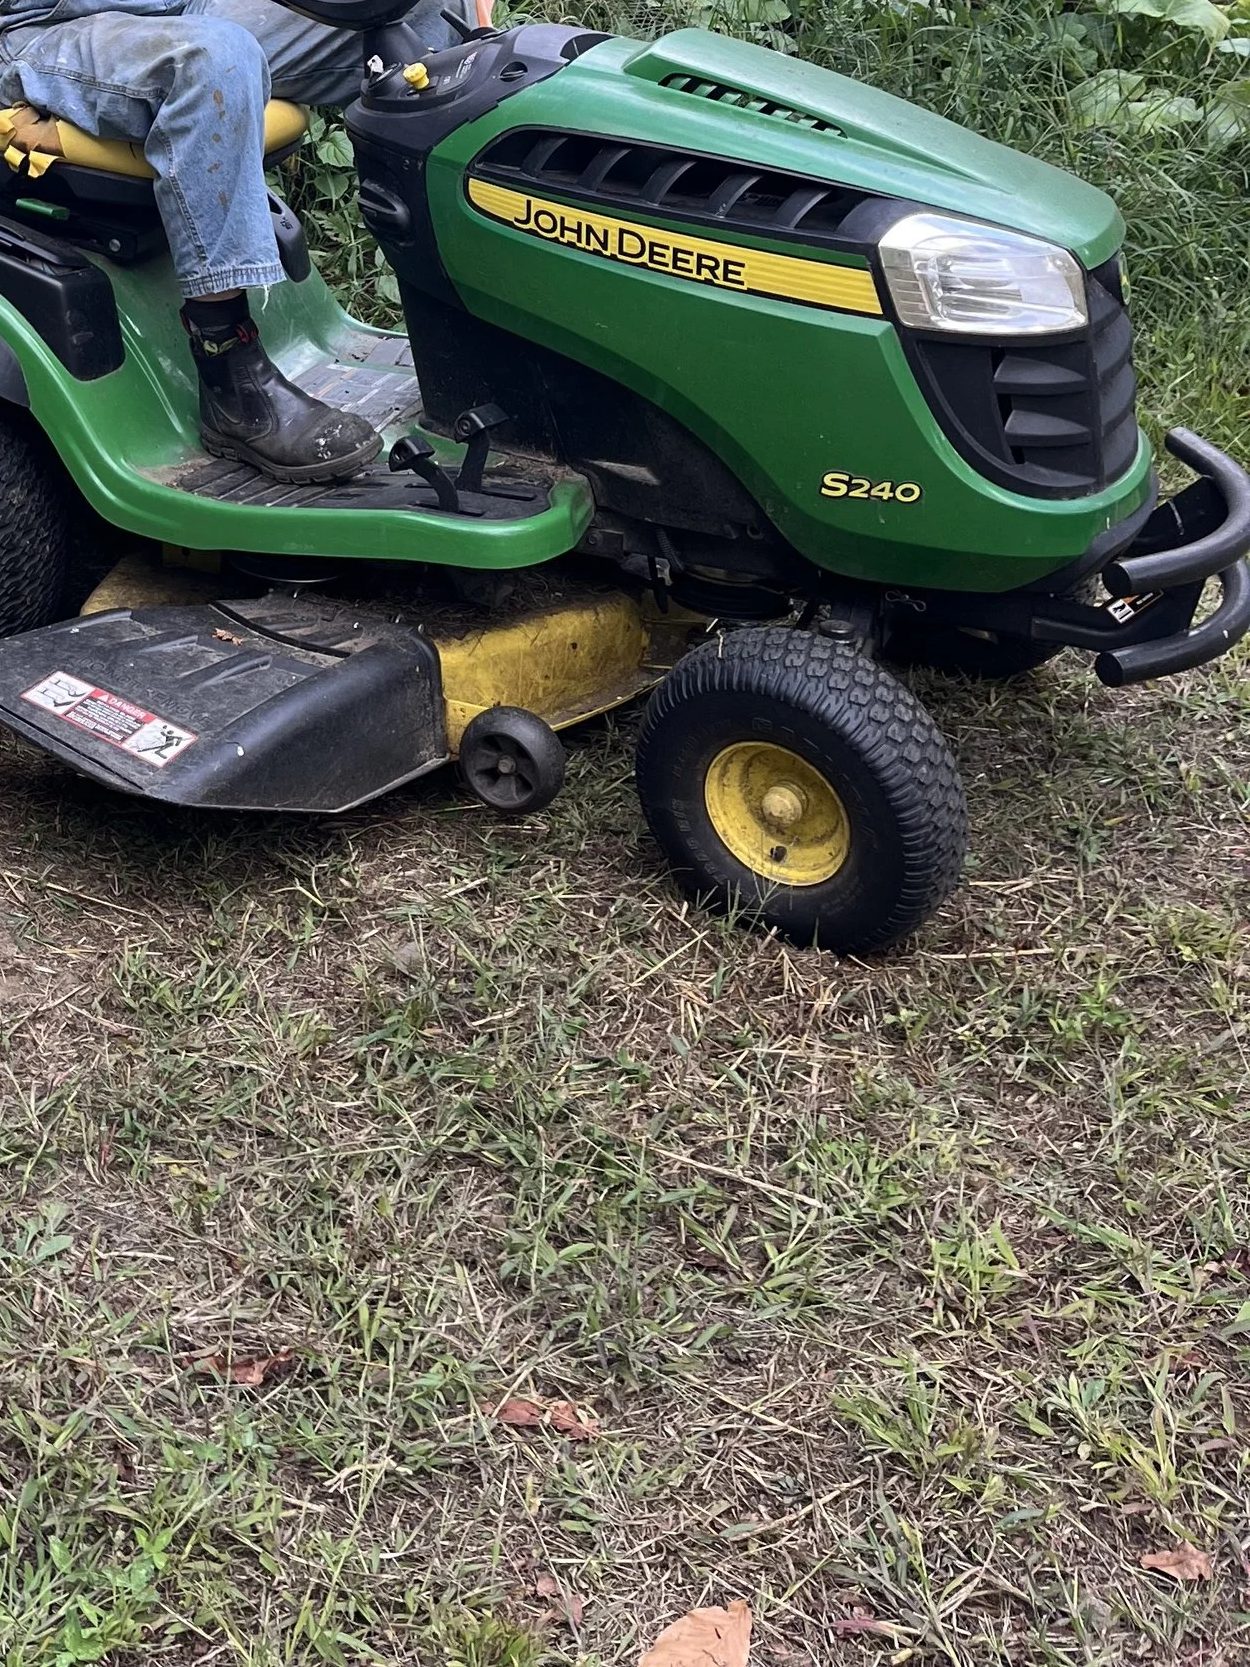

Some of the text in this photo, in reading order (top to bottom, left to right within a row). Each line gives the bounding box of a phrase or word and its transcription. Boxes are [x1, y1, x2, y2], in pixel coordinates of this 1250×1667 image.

[514, 199, 746, 287] JOHN DEERE
[820, 472, 921, 503] S240
[109, 696, 147, 720] DANGER
